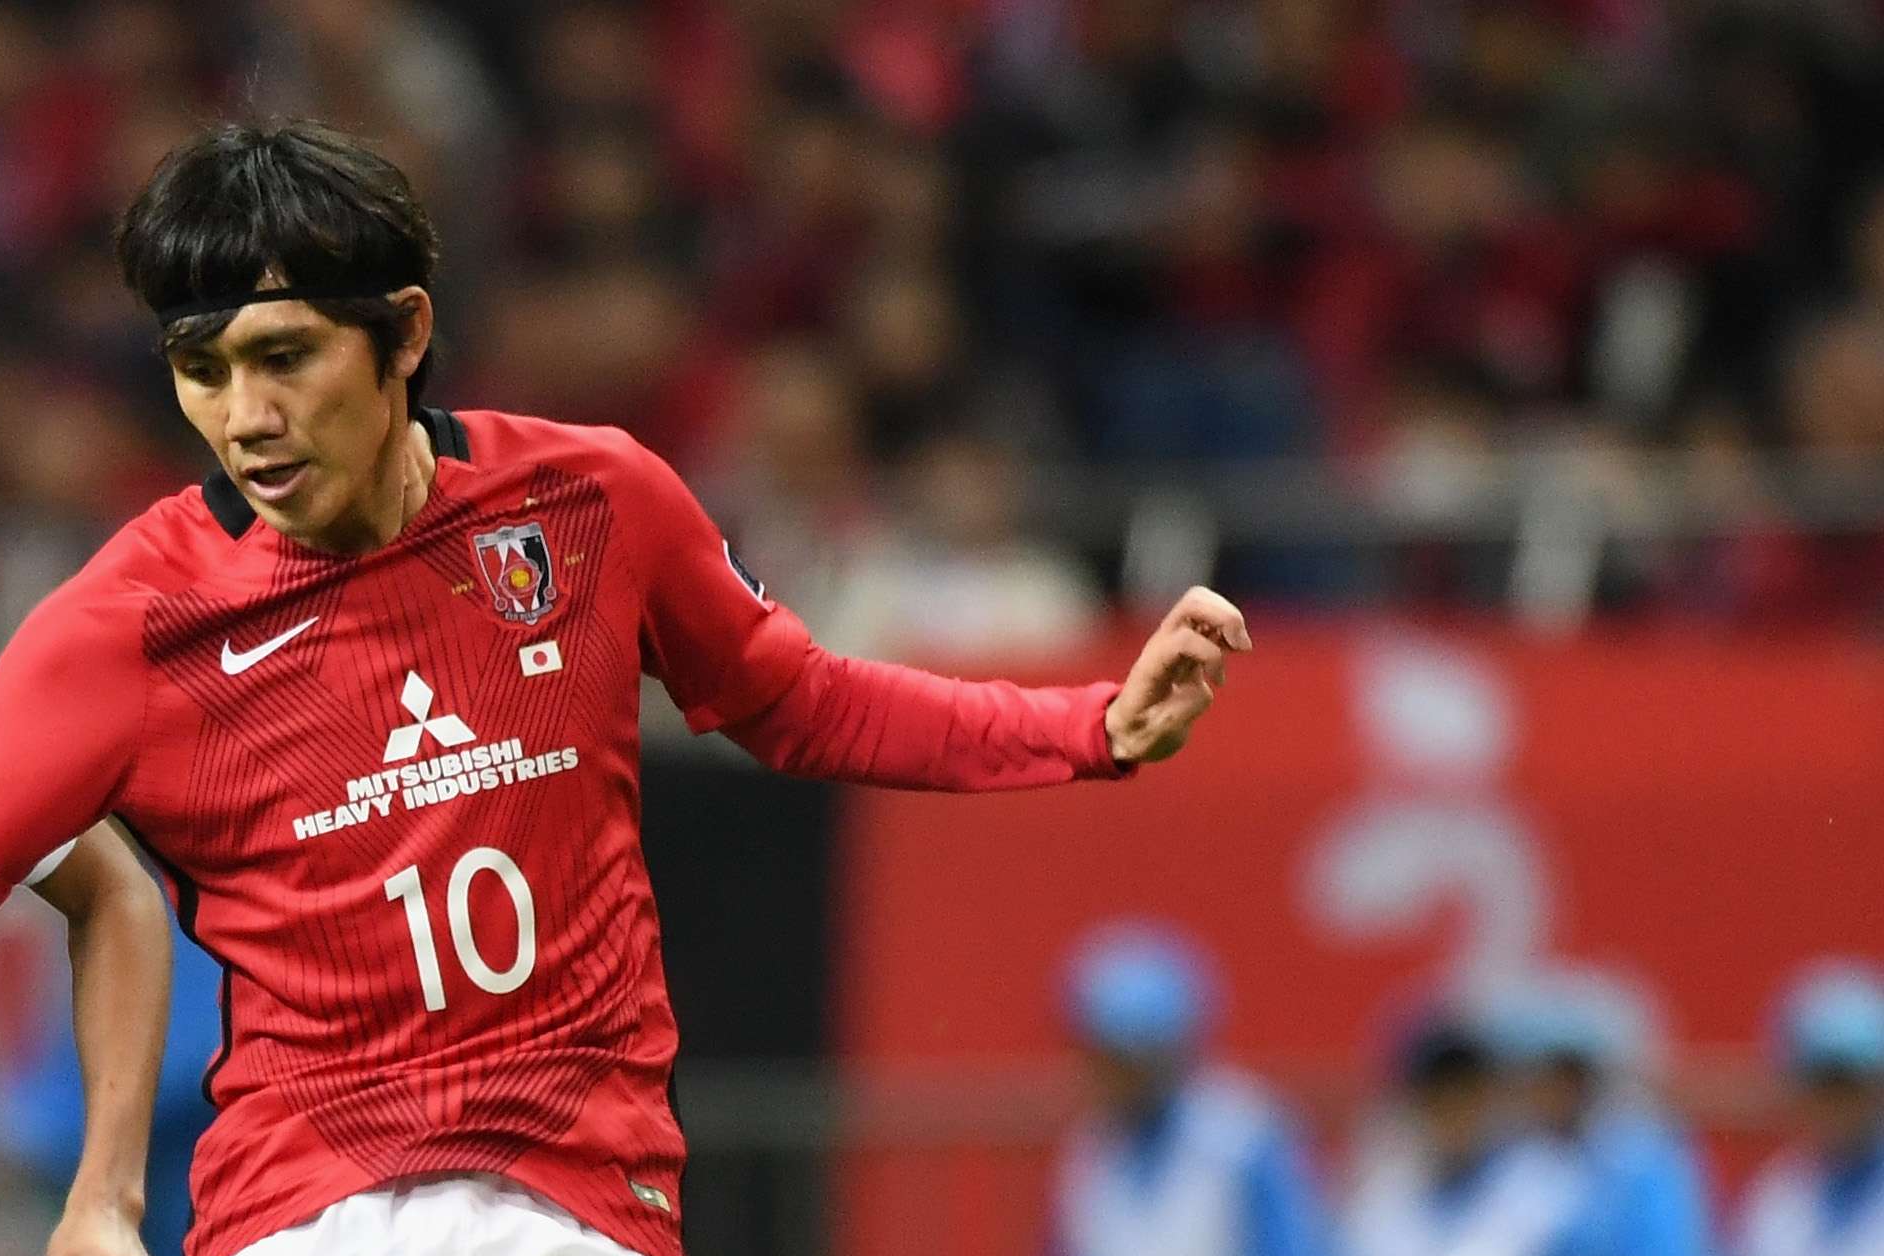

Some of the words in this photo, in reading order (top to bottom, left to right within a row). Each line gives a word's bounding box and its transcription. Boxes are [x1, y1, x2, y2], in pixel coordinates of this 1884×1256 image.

[292, 793, 394, 841] HEAVY
[402, 746, 580, 811] INDUSTRIES
[346, 738, 524, 803] MITSUBISHI
[383, 846, 537, 1012] 10
